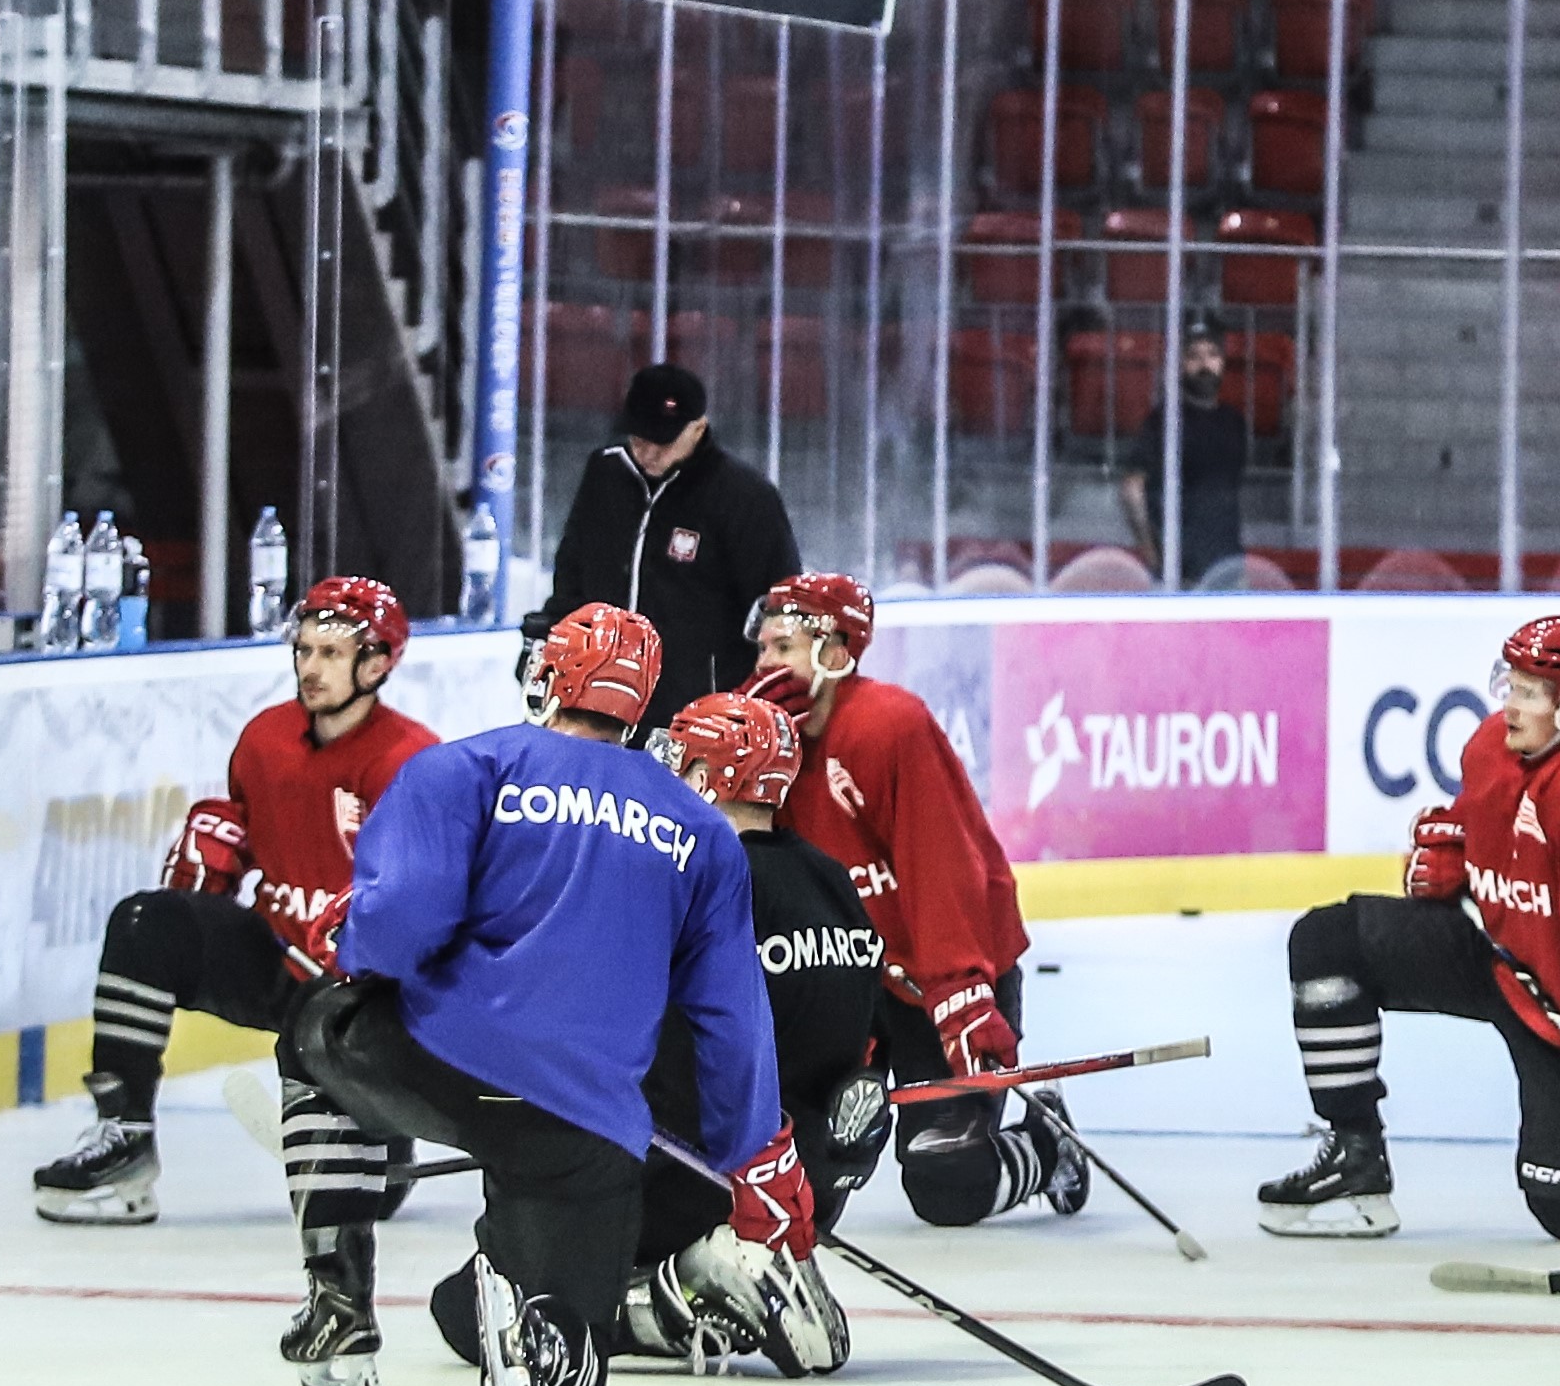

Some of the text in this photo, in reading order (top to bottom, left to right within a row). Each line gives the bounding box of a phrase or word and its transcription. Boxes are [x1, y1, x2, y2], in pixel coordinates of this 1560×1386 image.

[1082, 709, 1280, 789] TAURON
[190, 811, 247, 848] CC
[494, 783, 698, 873] COMARCH
[756, 926, 886, 976] OMARCH
